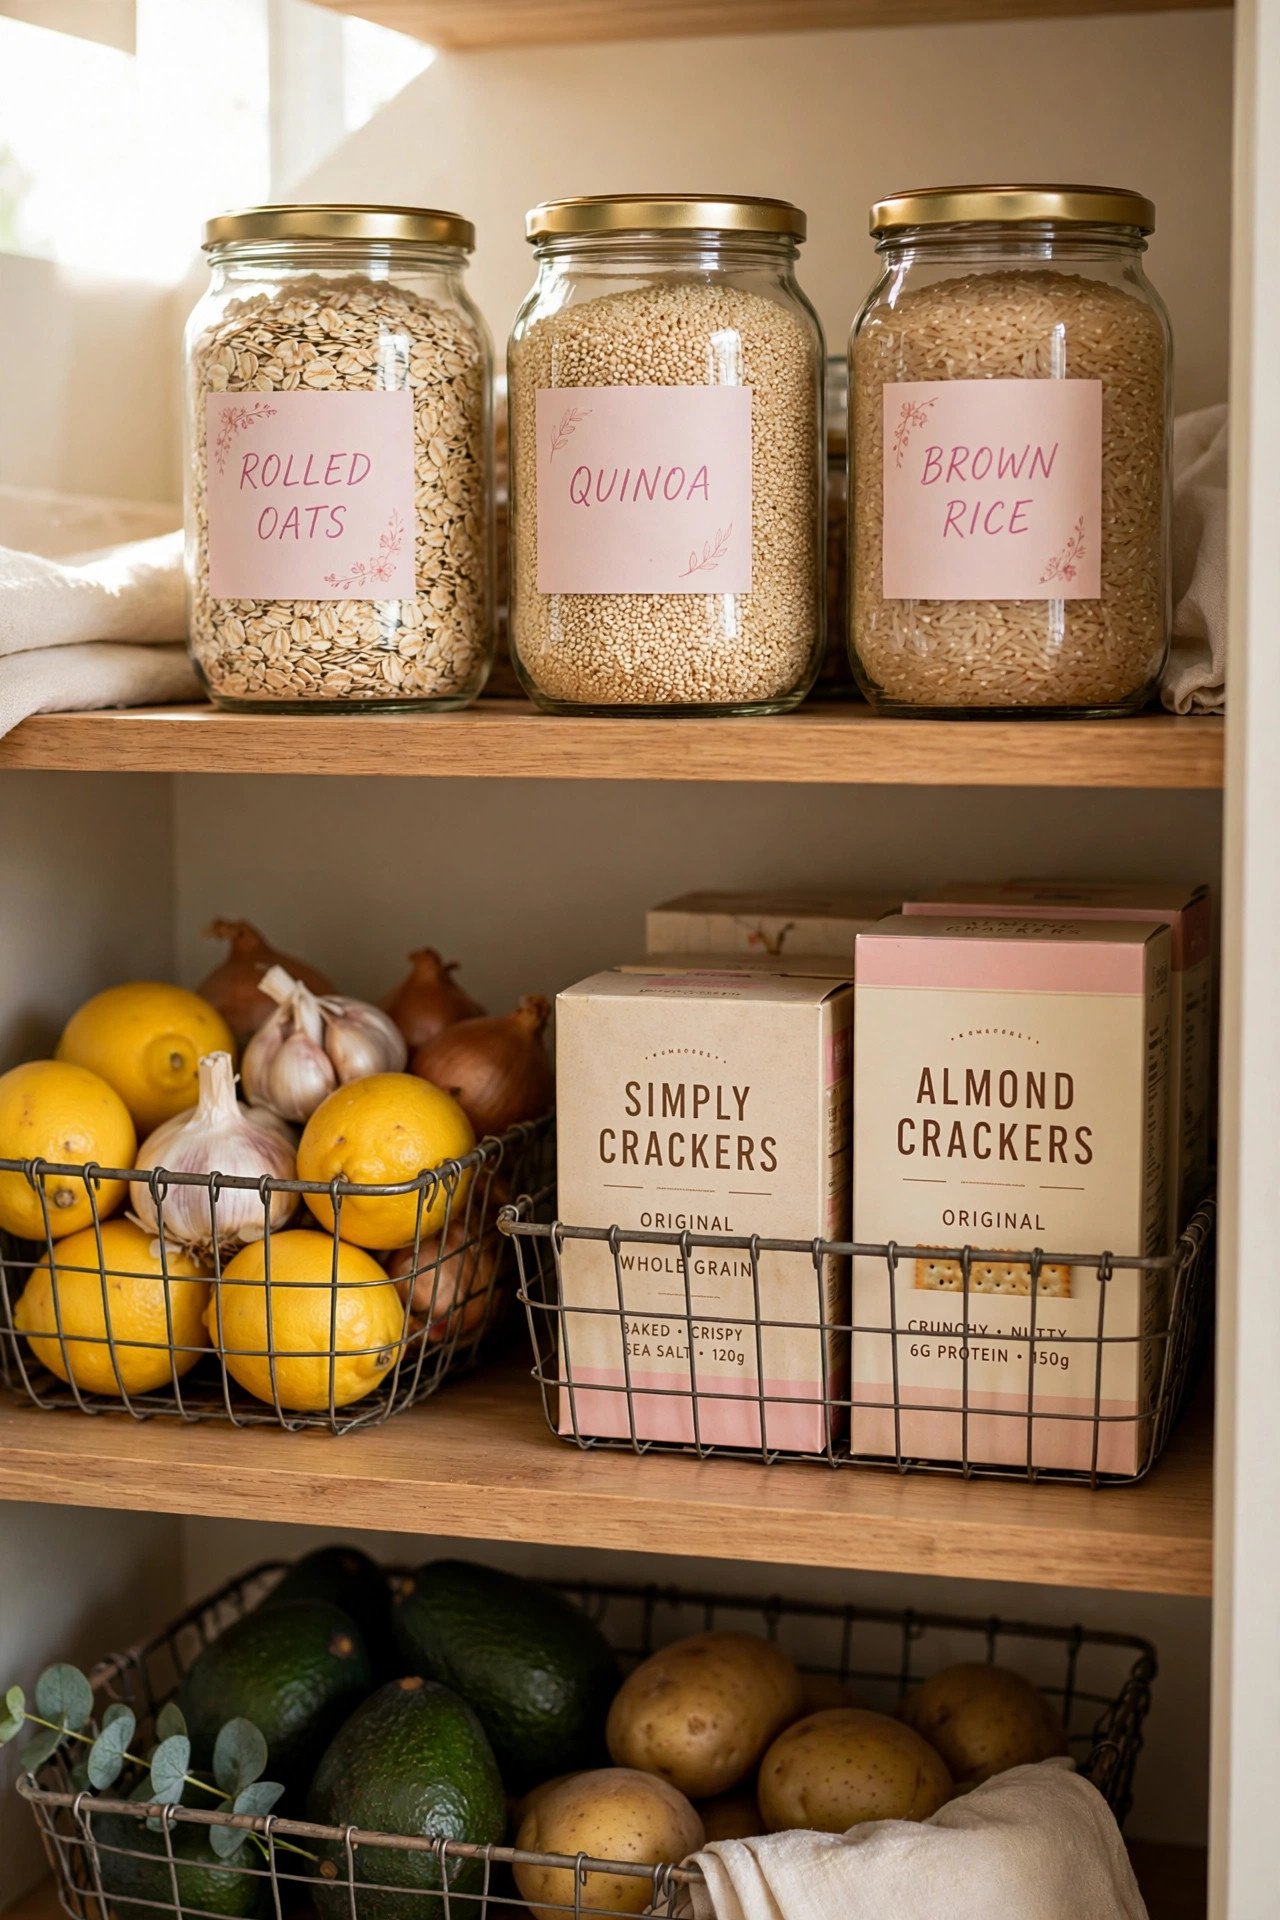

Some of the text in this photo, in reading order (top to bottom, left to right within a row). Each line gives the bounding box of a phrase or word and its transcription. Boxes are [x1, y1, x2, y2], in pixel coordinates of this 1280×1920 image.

[240, 453, 371, 490] ROLLED
[921, 443, 1058, 485] BROWN
[570, 465, 709, 507] QUINOA
[258, 505, 346, 540] OATS
[943, 499, 1033, 538] RICE
[625, 1081, 750, 1121] SIMPLY
[916, 1067, 1075, 1110] ALMOND
[599, 1128, 778, 1172] CRACKERS
[897, 1117, 1093, 1165] CRACKERS
[640, 1212, 734, 1232] ORIGINAL
[942, 1209, 1046, 1231] ORIGINAL
[620, 1255, 752, 1278] WHOLE GRAIN
[691, 1325, 743, 1342] CRISPY
[910, 1343, 931, 1358] 6G
[625, 1342, 745, 1366] SEA SALT 120g
